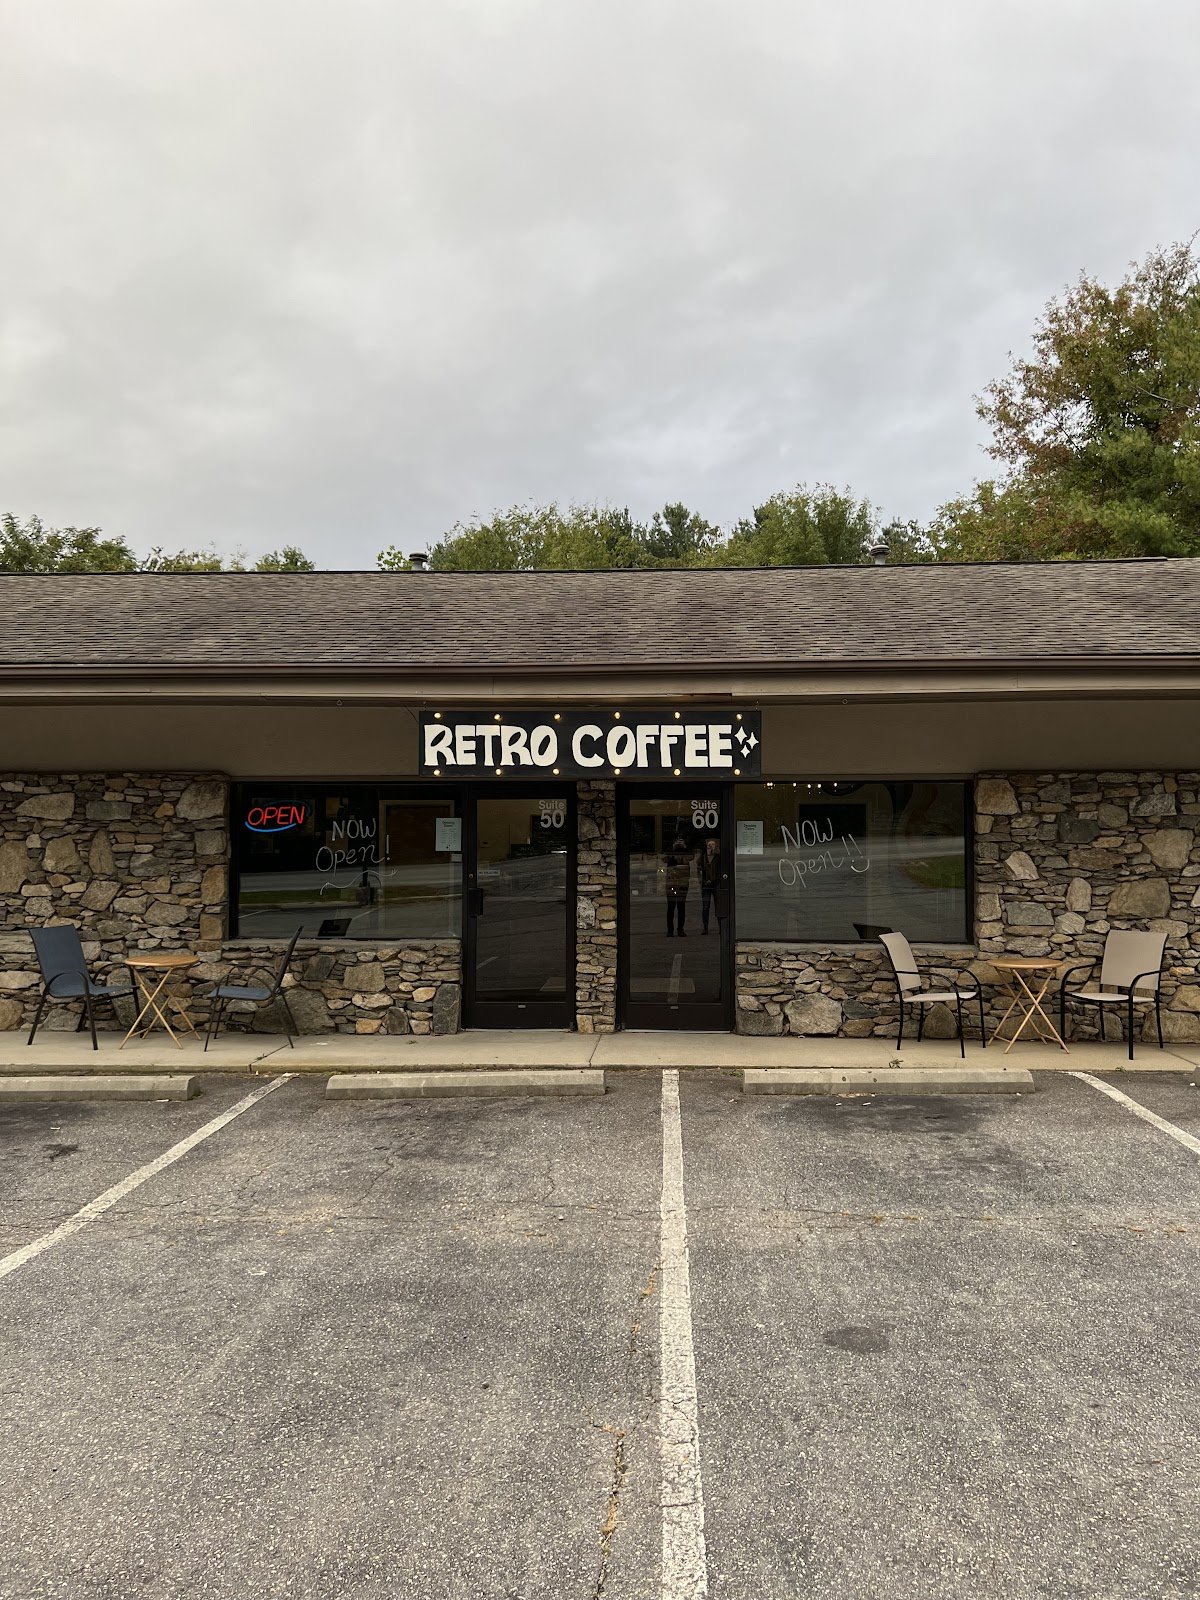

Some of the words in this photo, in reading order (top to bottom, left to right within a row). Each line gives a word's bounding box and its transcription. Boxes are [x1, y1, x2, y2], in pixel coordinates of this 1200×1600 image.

[424, 725, 558, 767] RETRO
[572, 725, 733, 768] COFFEE
[538, 800, 565, 810] Suite
[690, 800, 717, 810] Suite
[248, 806, 305, 826] OPEN
[540, 810, 565, 829] 50
[692, 810, 719, 829] 60
[331, 817, 377, 842] NOW
[781, 817, 833, 853] NOW
